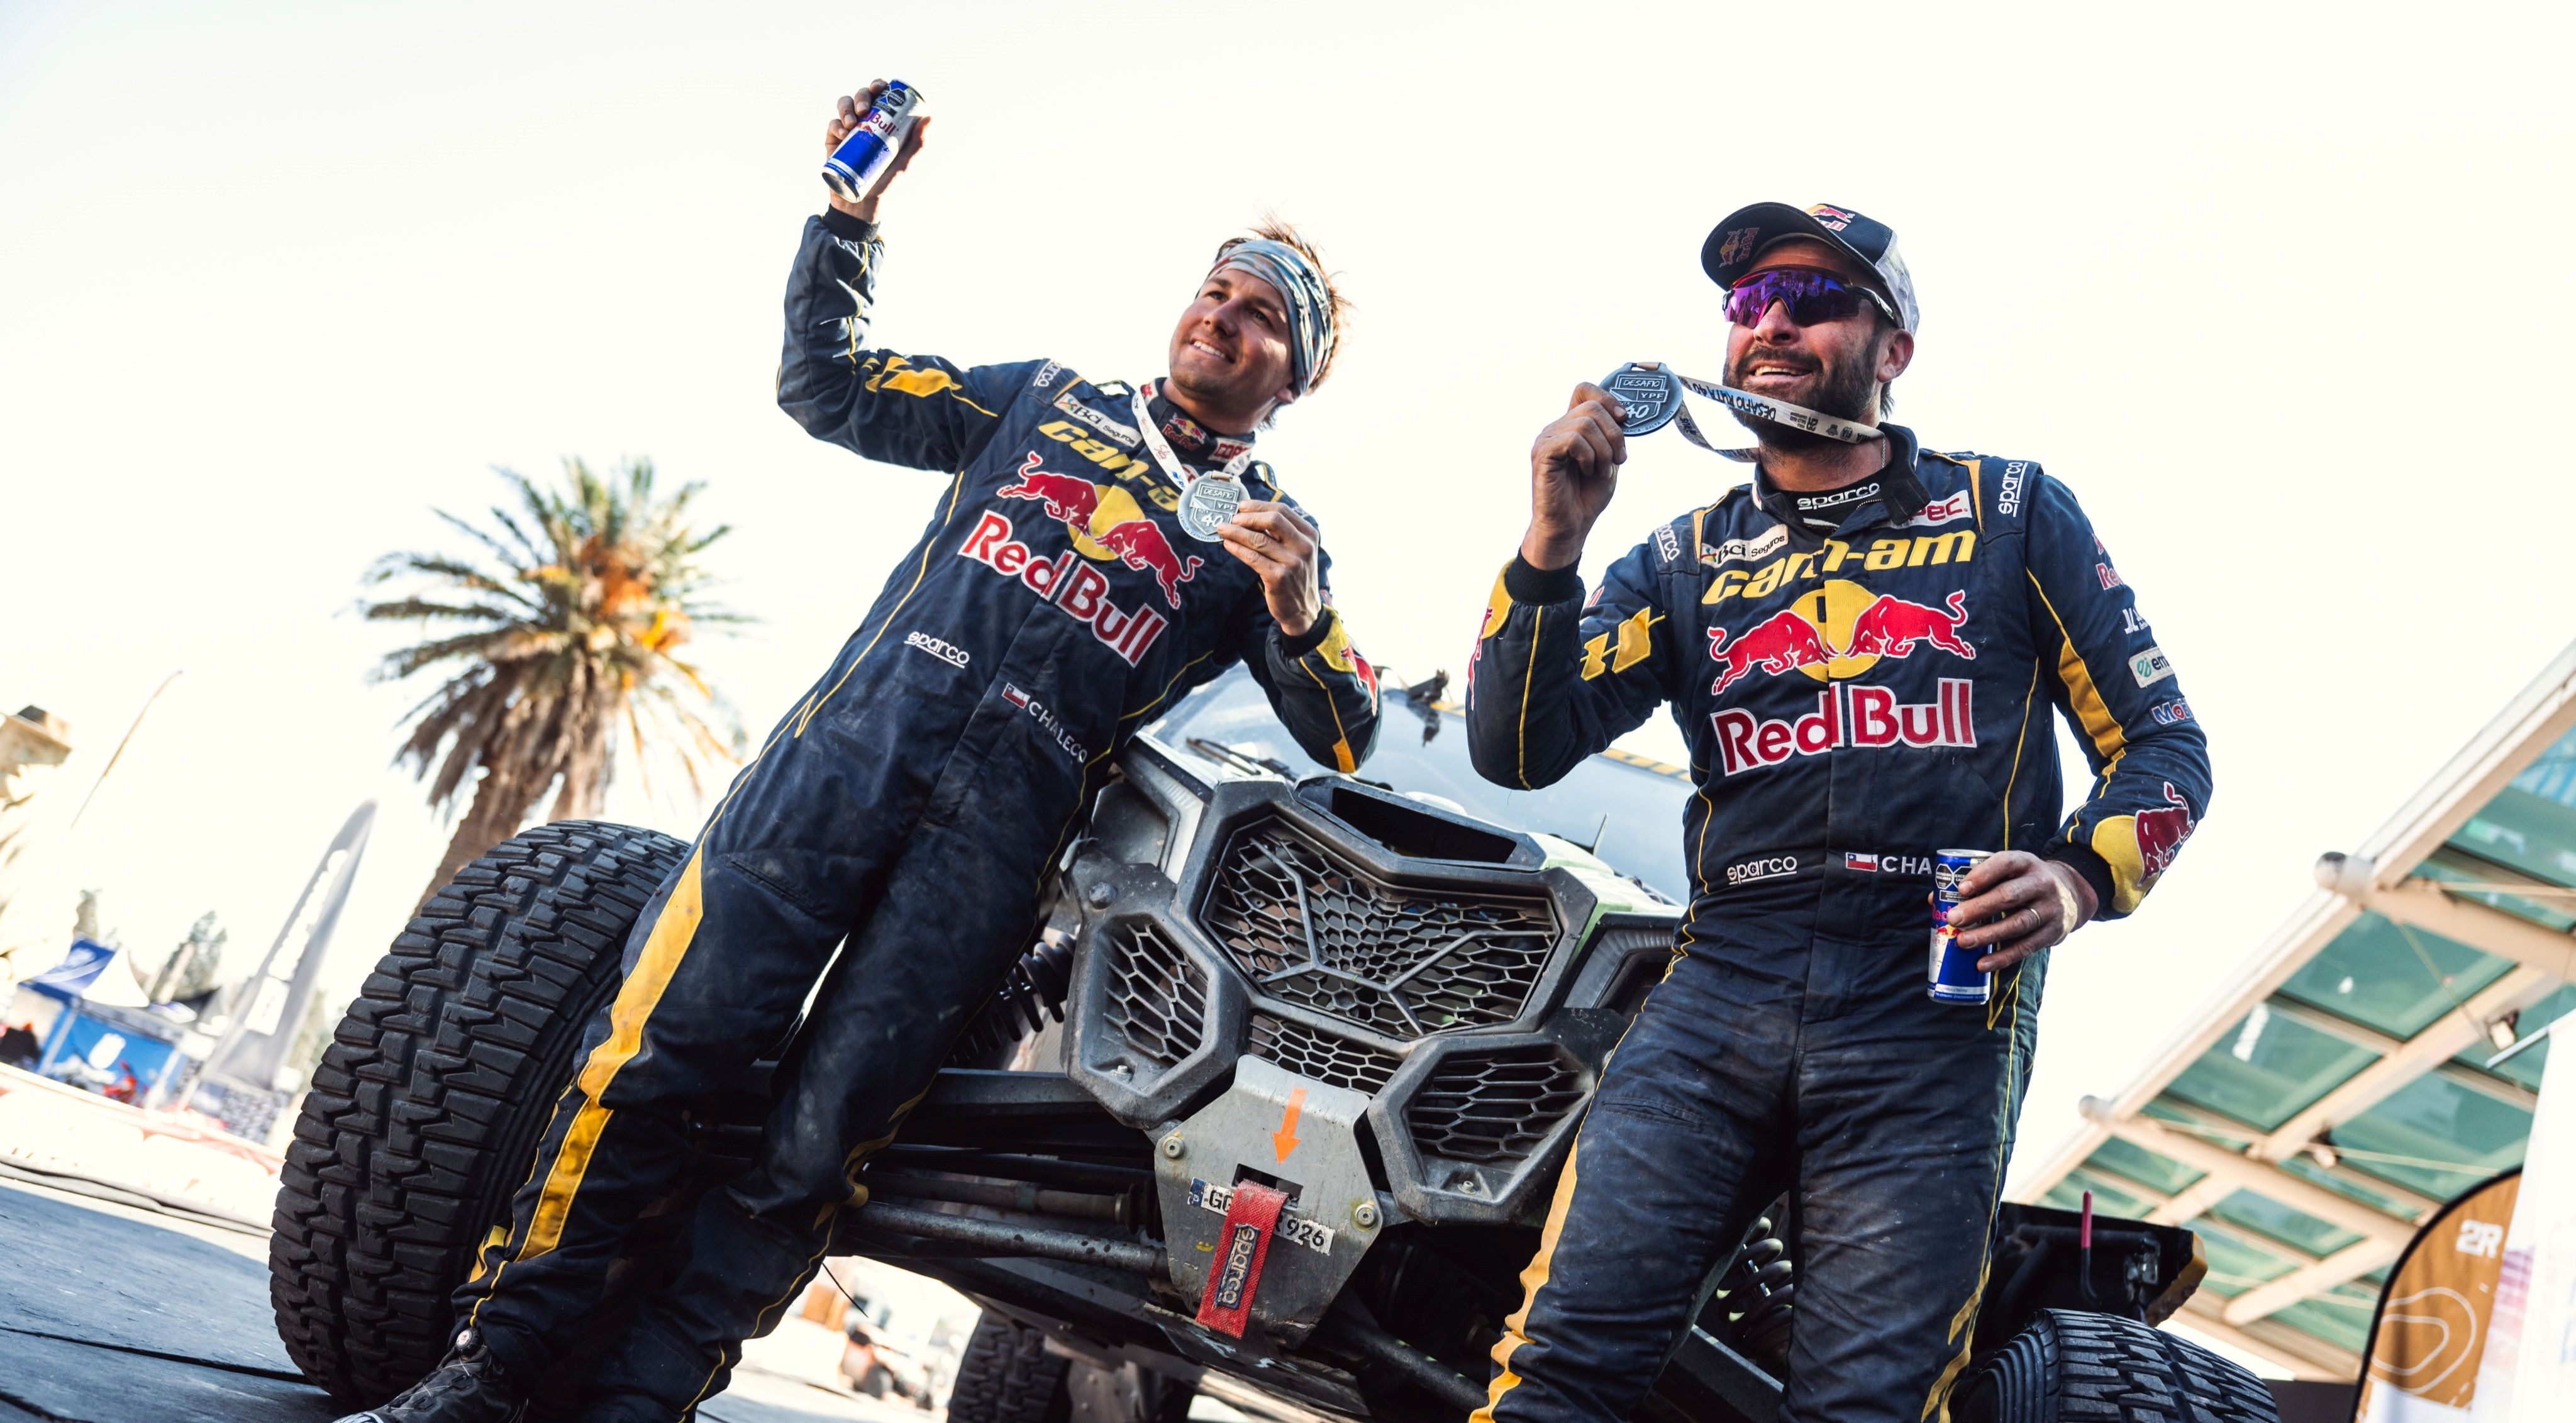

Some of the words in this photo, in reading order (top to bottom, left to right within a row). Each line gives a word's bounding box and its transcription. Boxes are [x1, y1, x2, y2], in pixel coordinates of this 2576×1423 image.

[870, 112, 897, 136] Bull
[1623, 379, 1660, 387] DESAFIO
[1625, 404, 1650, 419] 40
[1102, 424, 1136, 445] Seguros
[1162, 423, 1184, 444] Red
[1796, 482, 1880, 511] sparco
[1998, 462, 2028, 518] sparco
[1201, 513, 1224, 528] 40
[1751, 535, 1785, 557] Seguros
[1701, 530, 1977, 605] can-am
[2096, 563, 2121, 590] Re
[957, 510, 1077, 601] Red
[1055, 559, 1169, 668] Bull
[904, 631, 970, 668] sparco
[1028, 701, 1088, 763] CHALECO
[1710, 681, 1844, 777] Red
[1848, 677, 1977, 748] Bull
[1727, 856, 1797, 885] sparco
[1881, 856, 1932, 875] CHA
[2456, 1219, 2504, 1258] 2R
[1216, 1224, 1256, 1304] sparco
